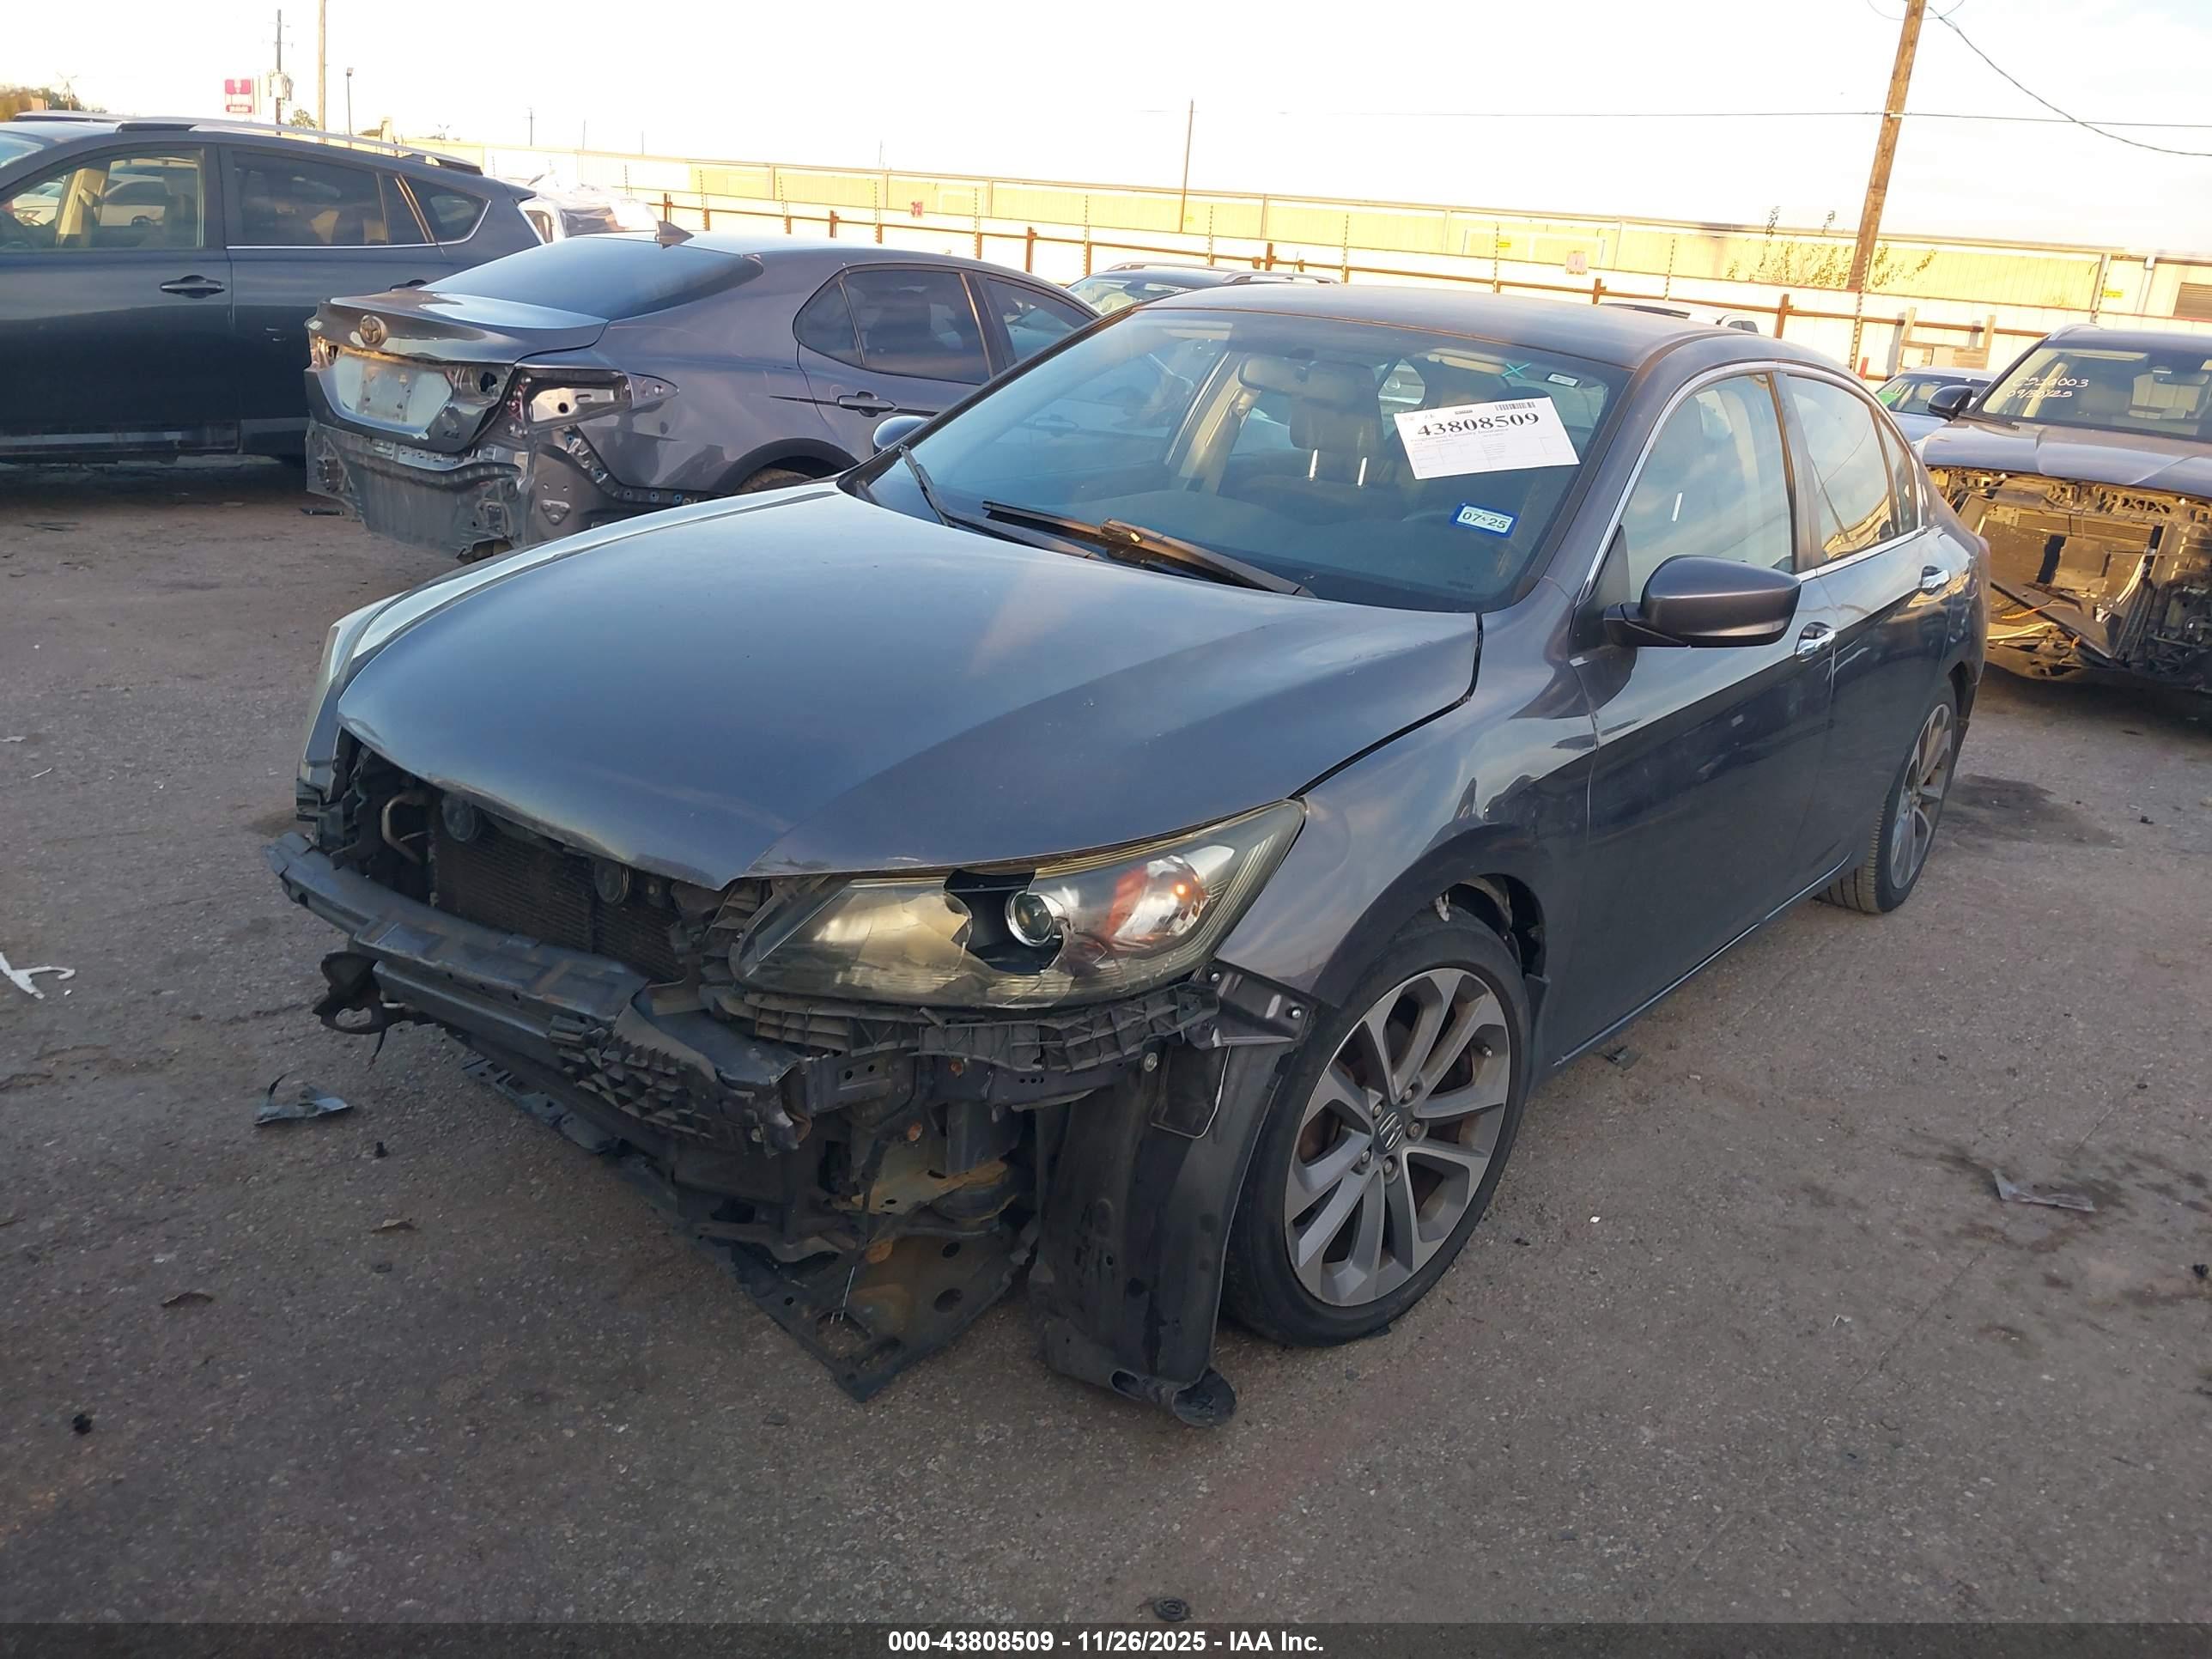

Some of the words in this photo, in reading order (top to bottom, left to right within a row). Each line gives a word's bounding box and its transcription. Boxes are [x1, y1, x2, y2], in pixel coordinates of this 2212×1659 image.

[1418, 412, 1540, 436] 43808509
[1462, 512, 1482, 522] 07
[1487, 518, 1508, 529] 25
